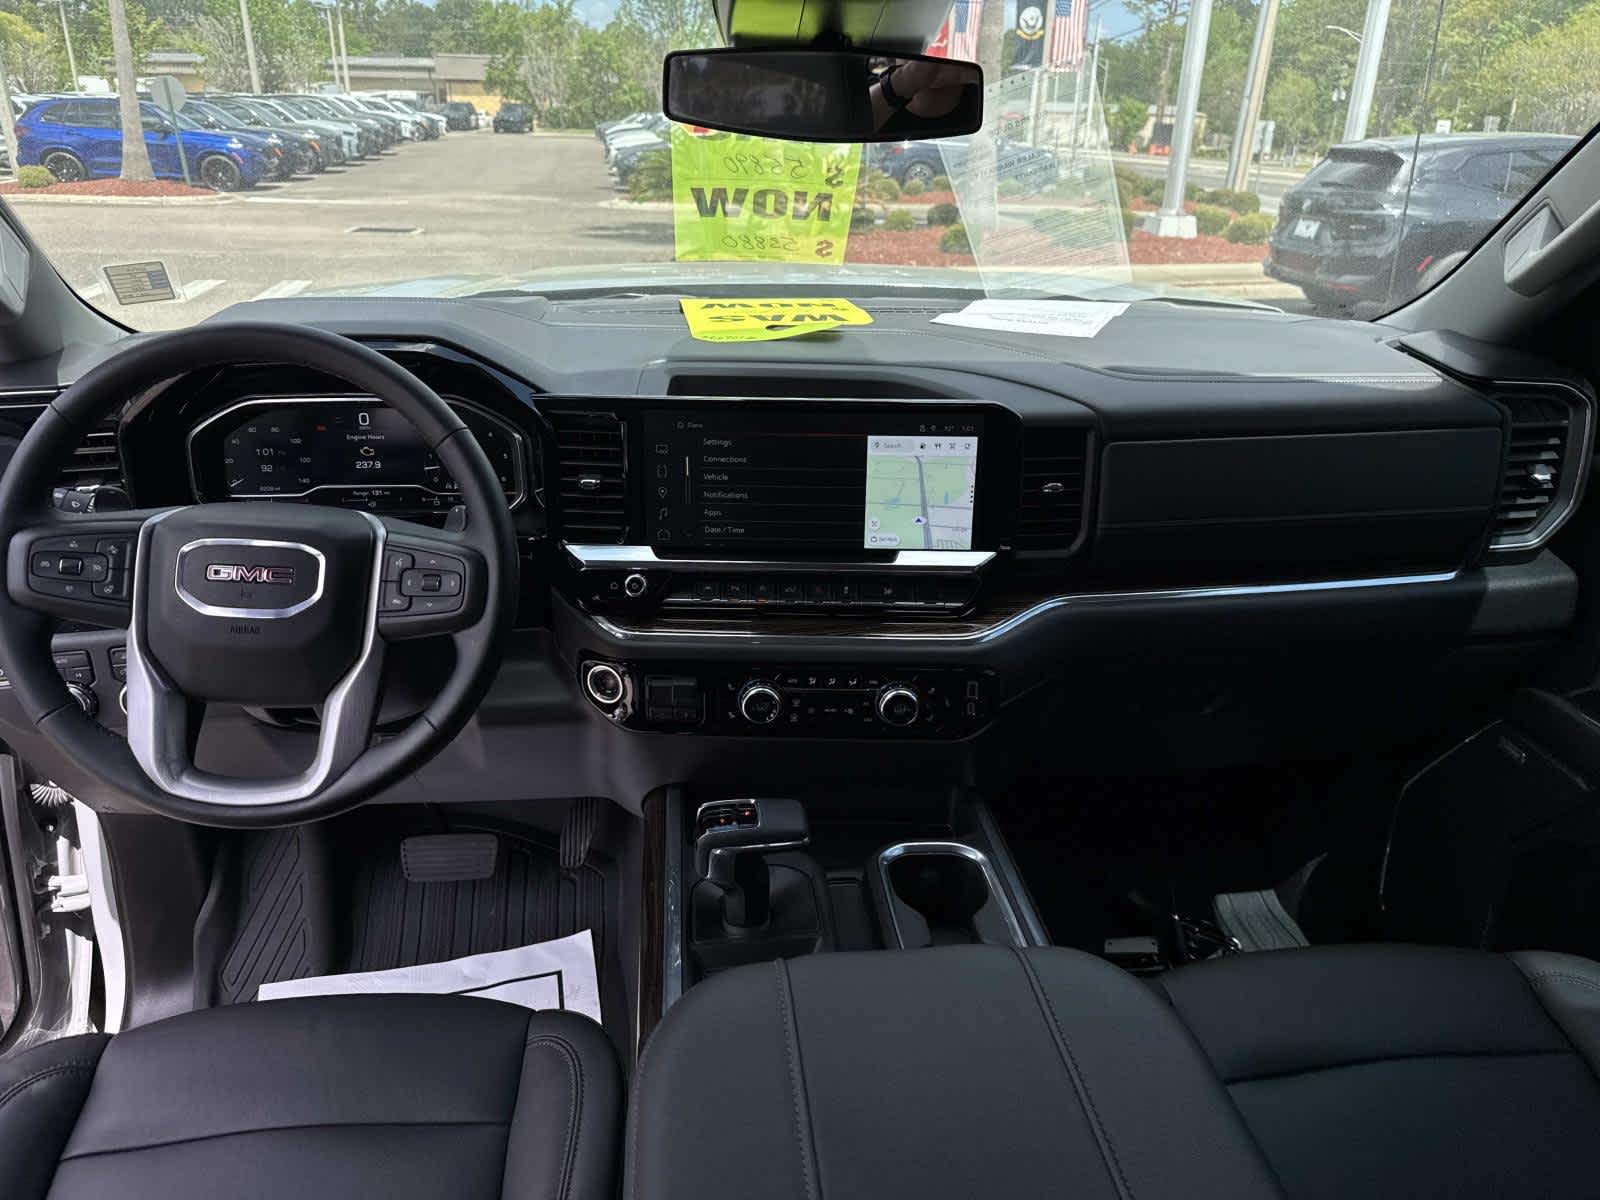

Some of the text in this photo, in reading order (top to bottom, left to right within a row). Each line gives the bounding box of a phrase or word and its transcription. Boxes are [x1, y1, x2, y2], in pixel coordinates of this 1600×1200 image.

[358, 412, 370, 426] 0
[704, 438, 732, 448] Settings
[255, 448, 274, 456] 101
[703, 455, 747, 463] Connections
[260, 464, 273, 472] 92
[355, 461, 382, 469] 237.9
[703, 473, 729, 481] Vehicle
[703, 490, 748, 499] Notifications
[703, 509, 722, 518] Apps
[207, 564, 293, 584] GMC
